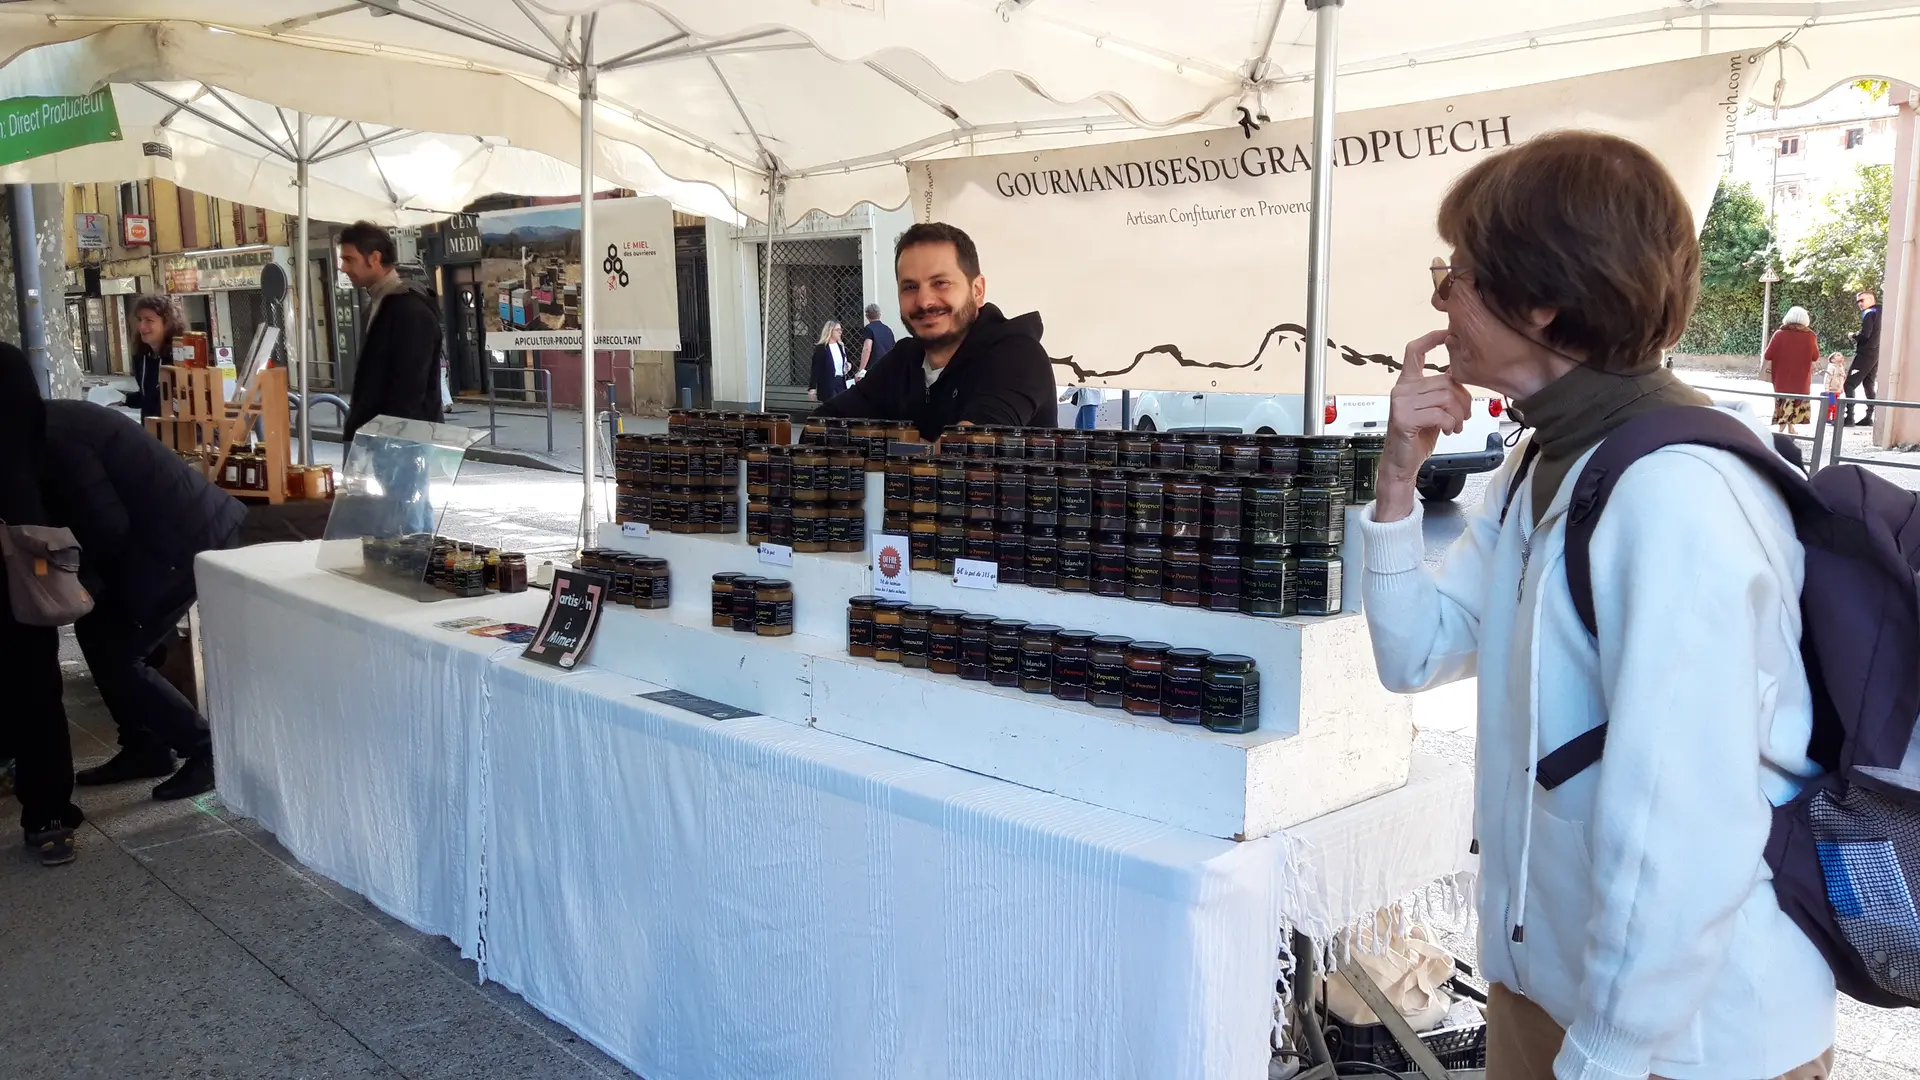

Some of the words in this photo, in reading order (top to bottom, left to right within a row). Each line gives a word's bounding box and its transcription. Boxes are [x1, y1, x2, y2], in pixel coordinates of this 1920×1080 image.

[9, 108, 40, 137] Direct
[42, 91, 105, 127] Producteur
[1126, 211, 1168, 226] Artisan
[1169, 203, 1237, 227] Confiturier
[1240, 206, 1256, 218] en
[1032, 494, 1053, 503] Sauvage
[882, 556, 897, 564] OFFRE
[1031, 555, 1052, 563] Sauvage
[564, 618, 572, 630] à
[547, 631, 576, 647] Mimet
[993, 654, 1014, 663] Sauvage
[1026, 659, 1047, 668] blanche
[1096, 673, 1121, 681] Provence
